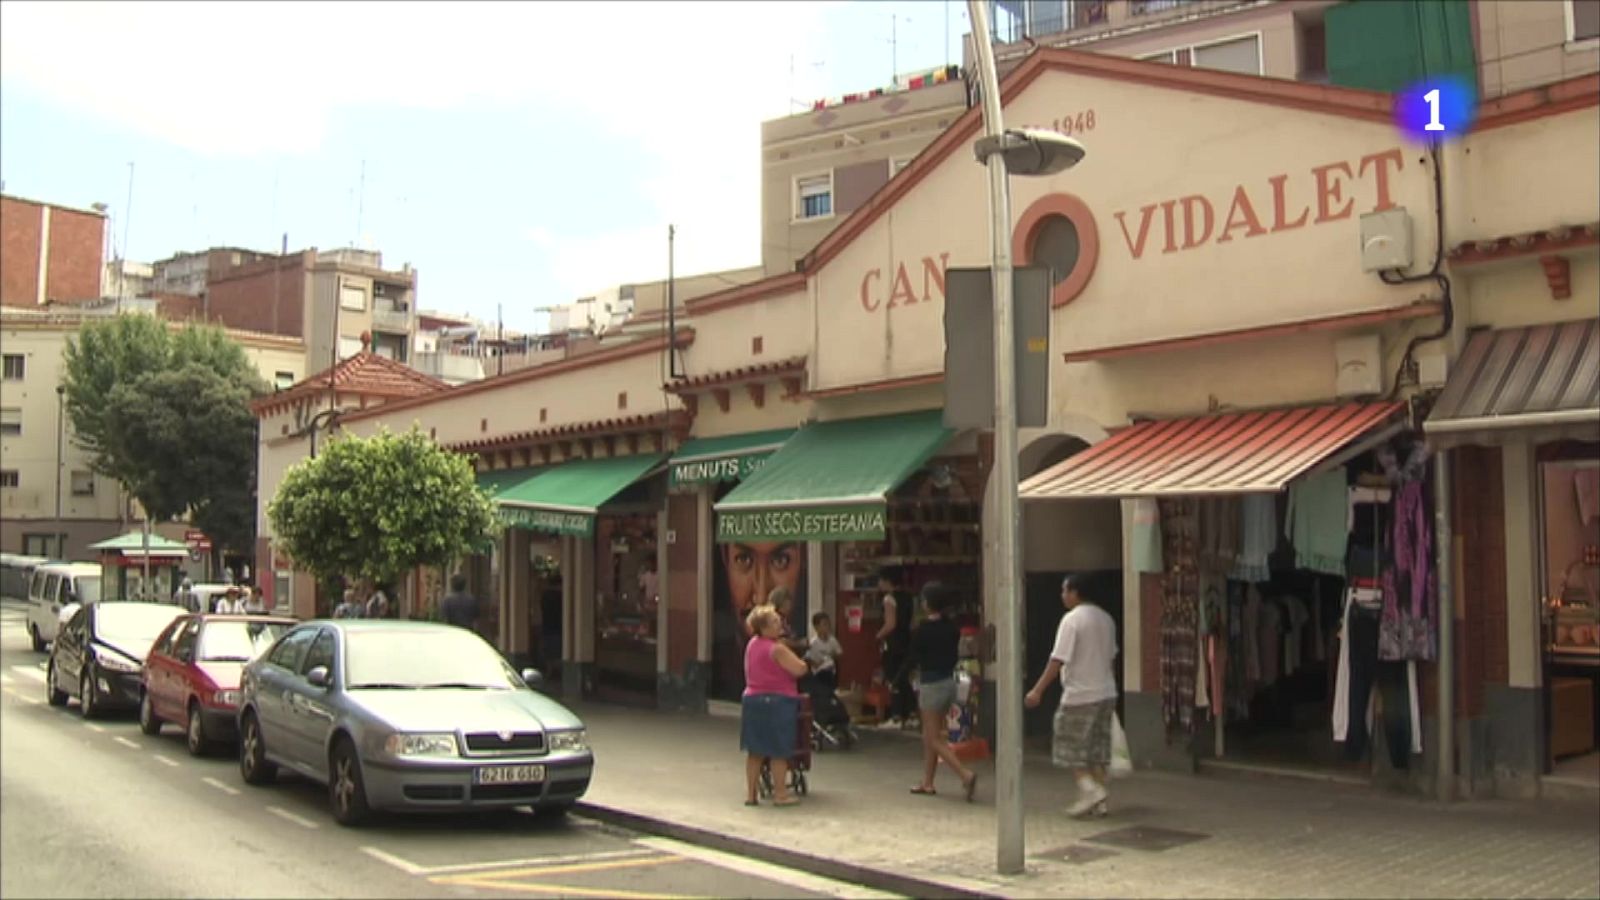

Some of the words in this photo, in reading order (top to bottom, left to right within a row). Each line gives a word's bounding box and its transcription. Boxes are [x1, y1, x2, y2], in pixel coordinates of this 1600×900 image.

[1053, 109, 1095, 137] 1948
[861, 252, 950, 313] CAN
[1113, 148, 1404, 260] VIDALET
[675, 458, 738, 481] MENUTS
[719, 513, 760, 536] FRUITS
[764, 512, 800, 535] SECS
[803, 510, 885, 533] ESTEFANIA
